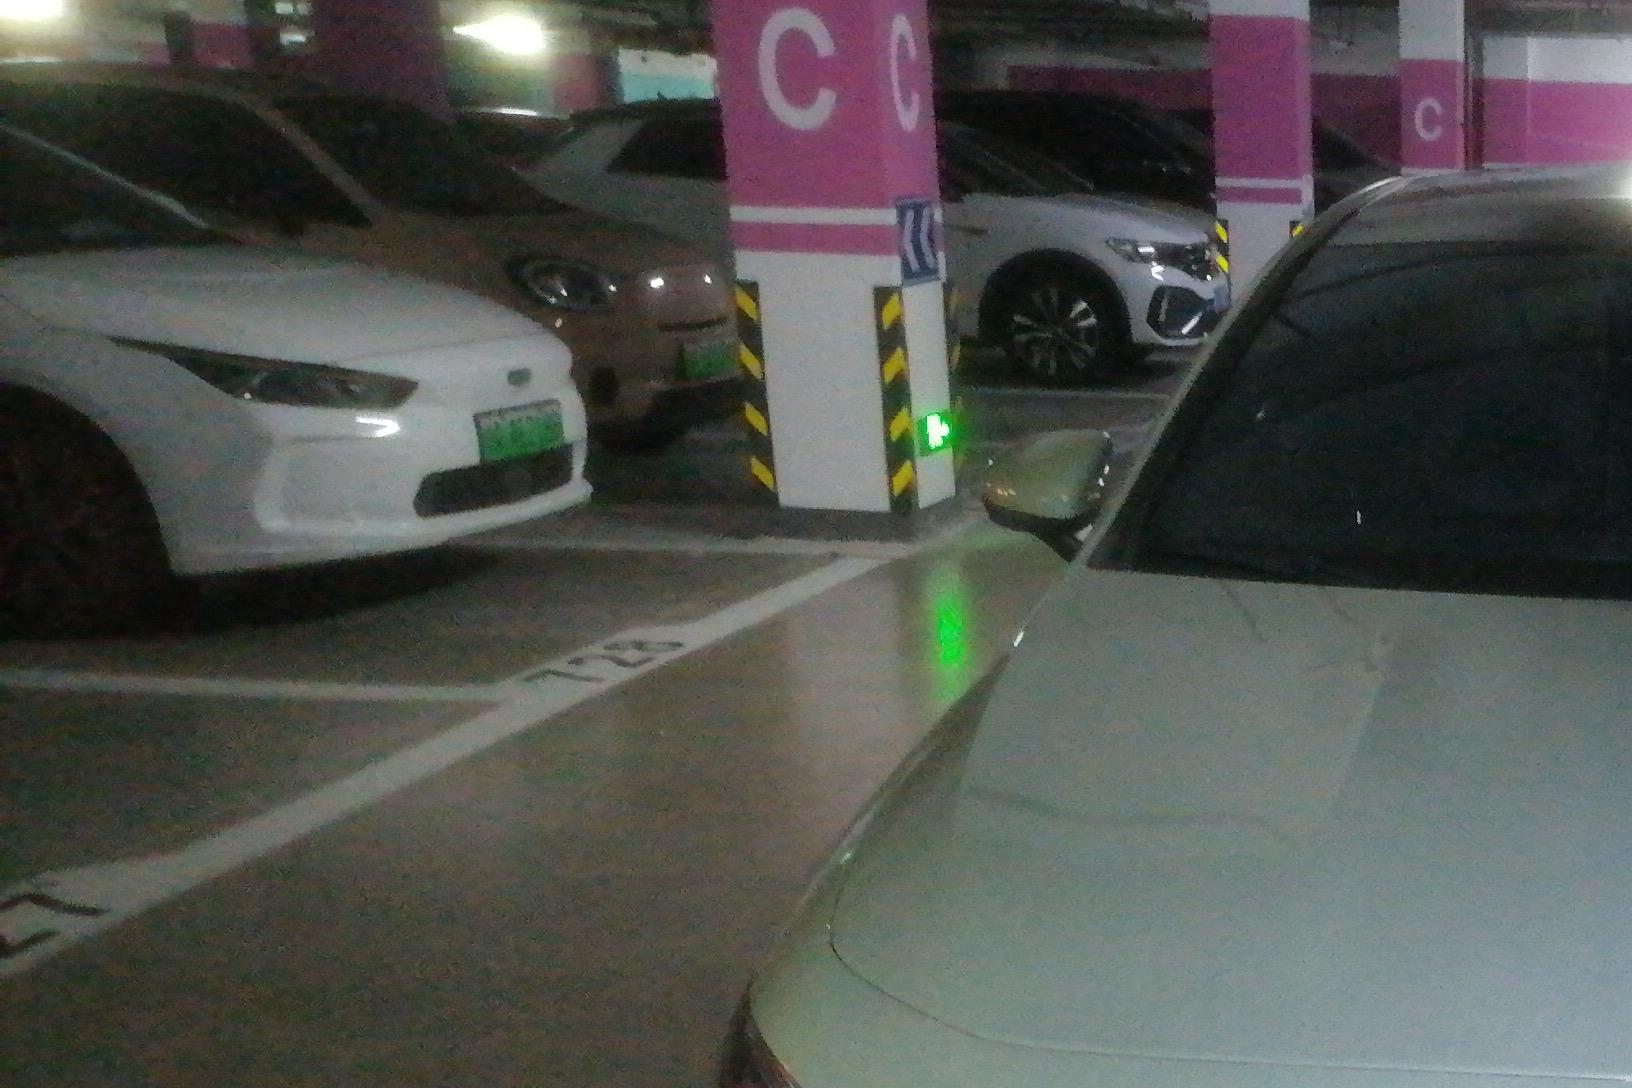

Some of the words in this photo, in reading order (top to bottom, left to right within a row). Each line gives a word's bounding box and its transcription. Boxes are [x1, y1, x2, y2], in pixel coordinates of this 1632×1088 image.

[758, 6, 837, 131] C
[890, 13, 920, 132] C
[1414, 98, 1443, 141] C
